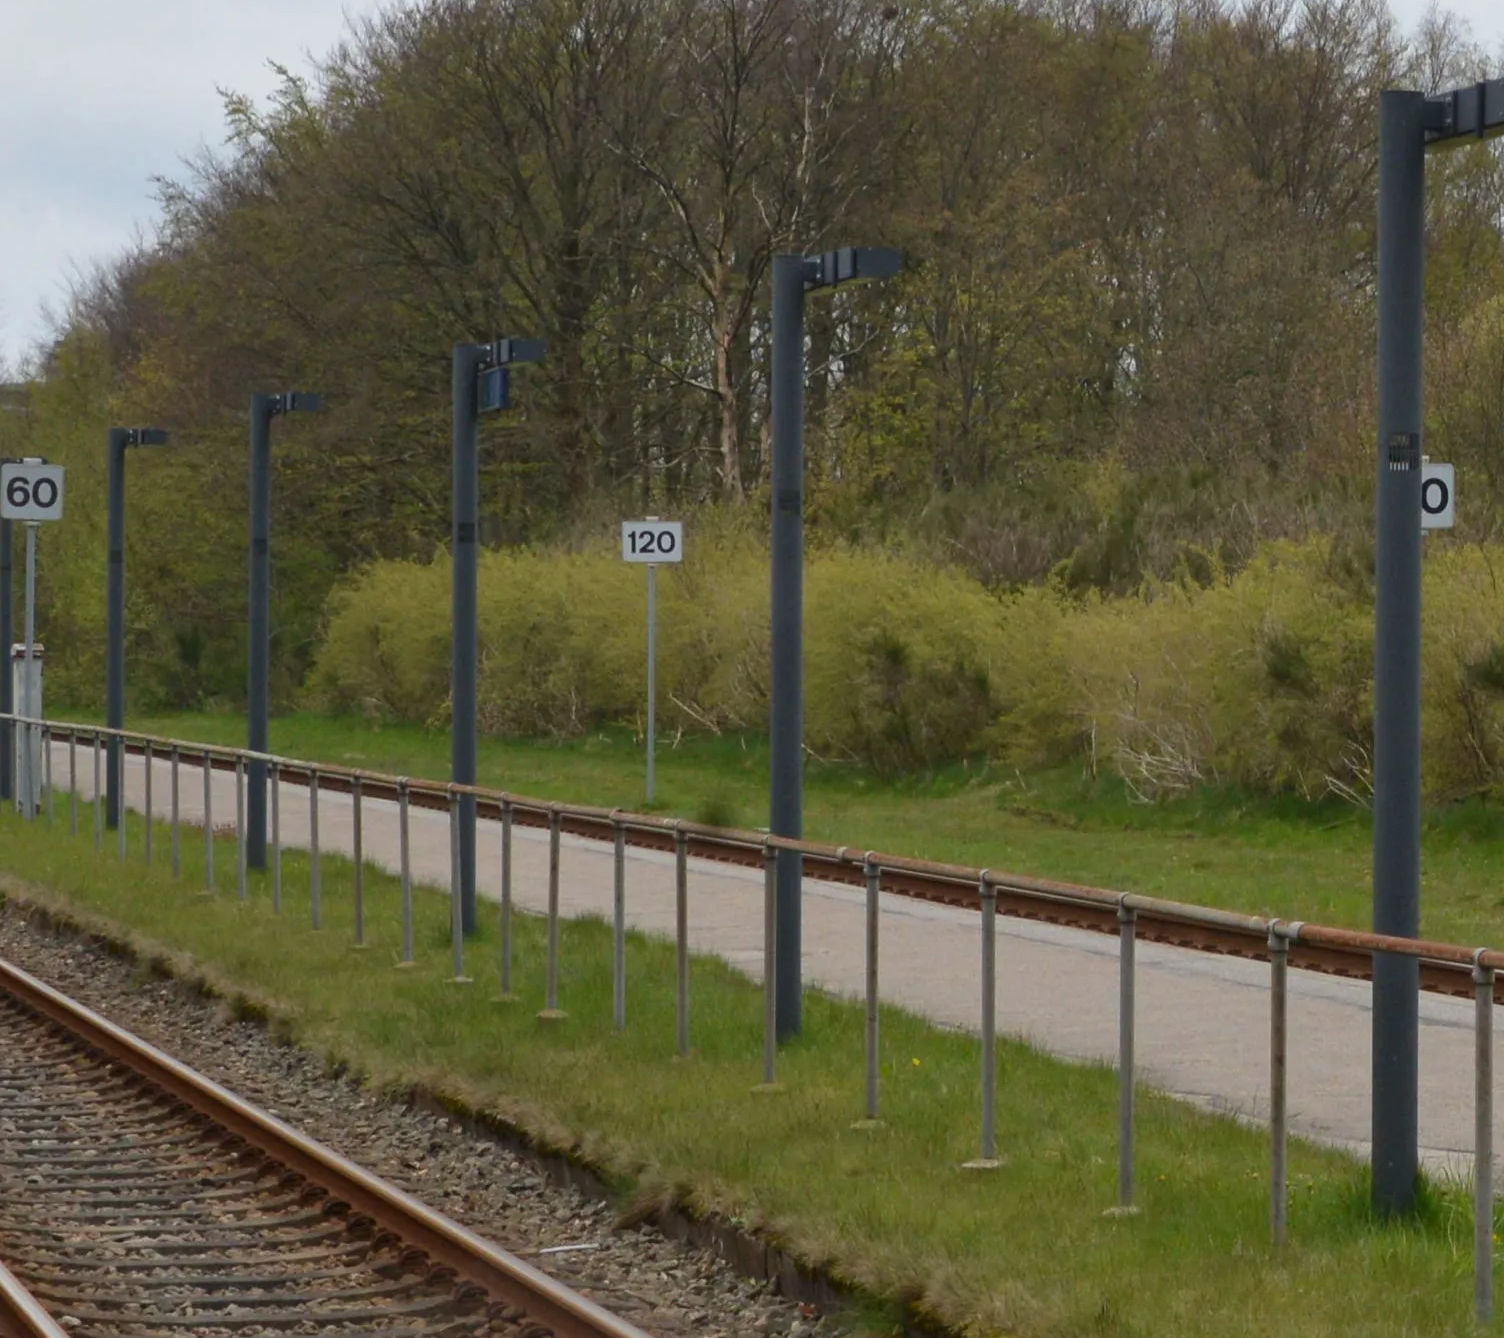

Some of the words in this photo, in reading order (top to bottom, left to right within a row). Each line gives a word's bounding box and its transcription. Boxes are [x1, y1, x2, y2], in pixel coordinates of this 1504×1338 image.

[6, 476, 58, 509] 60
[1421, 477, 1449, 515] 0
[627, 530, 676, 554] 120
